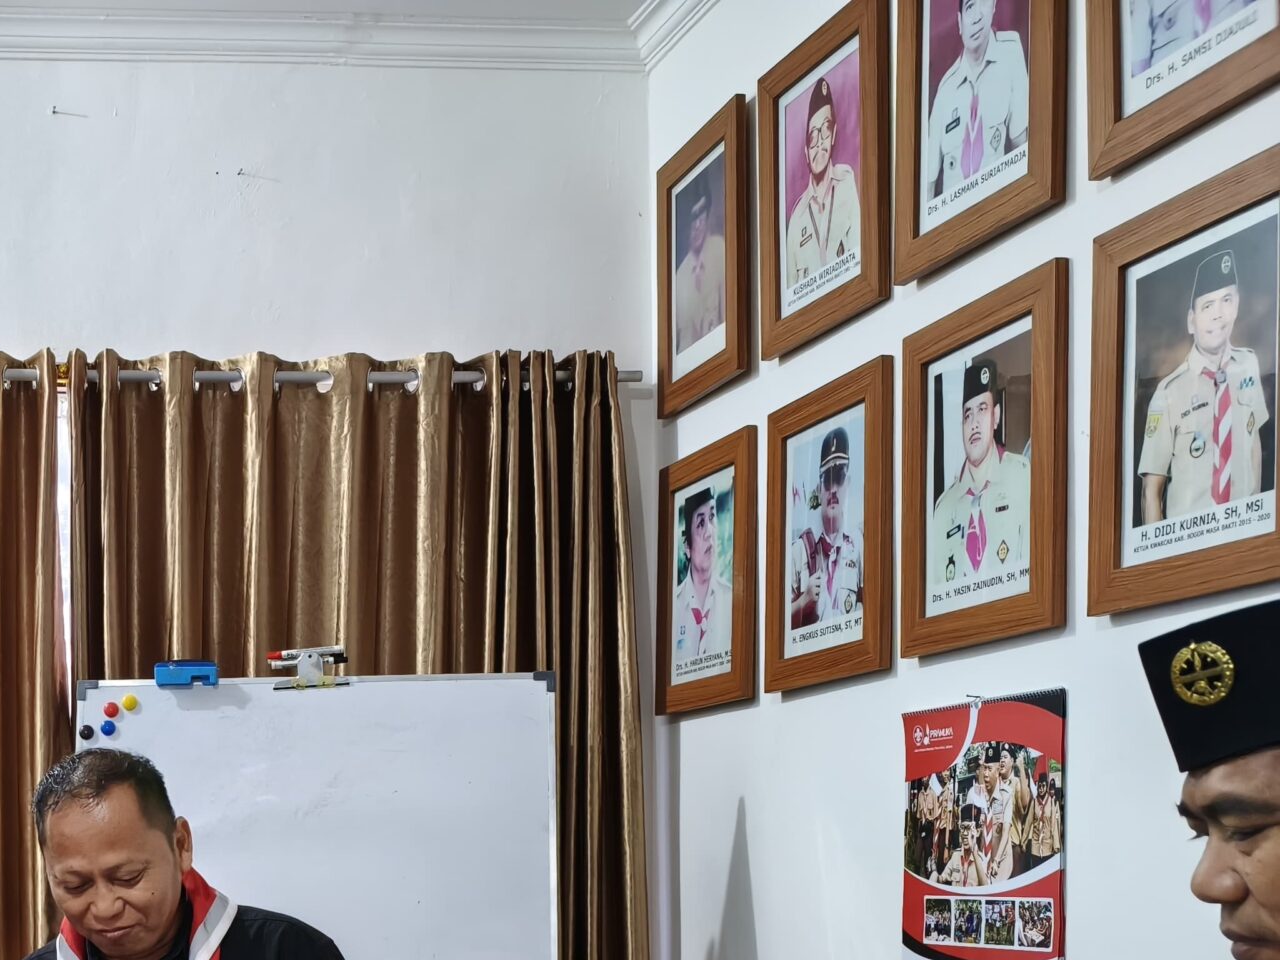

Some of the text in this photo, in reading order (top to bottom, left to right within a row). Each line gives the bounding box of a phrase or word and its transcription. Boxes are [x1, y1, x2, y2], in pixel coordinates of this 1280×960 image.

[1145, 73, 1164, 89] Drs.
[1168, 62, 1178, 76] H.
[1181, 38, 1213, 67] SAMSI
[928, 150, 1026, 216] Drs. H. LASMANA SURIATMADJA
[1141, 498, 1263, 542] H. DIDI KURNIA, SH, MSi
[932, 568, 1030, 603] Drs. H. YASIN ZAINUDIN, SH, MM
[792, 636, 797, 644] H.
[820, 624, 843, 636] SUTISNA,
[854, 617, 862, 626] MT
